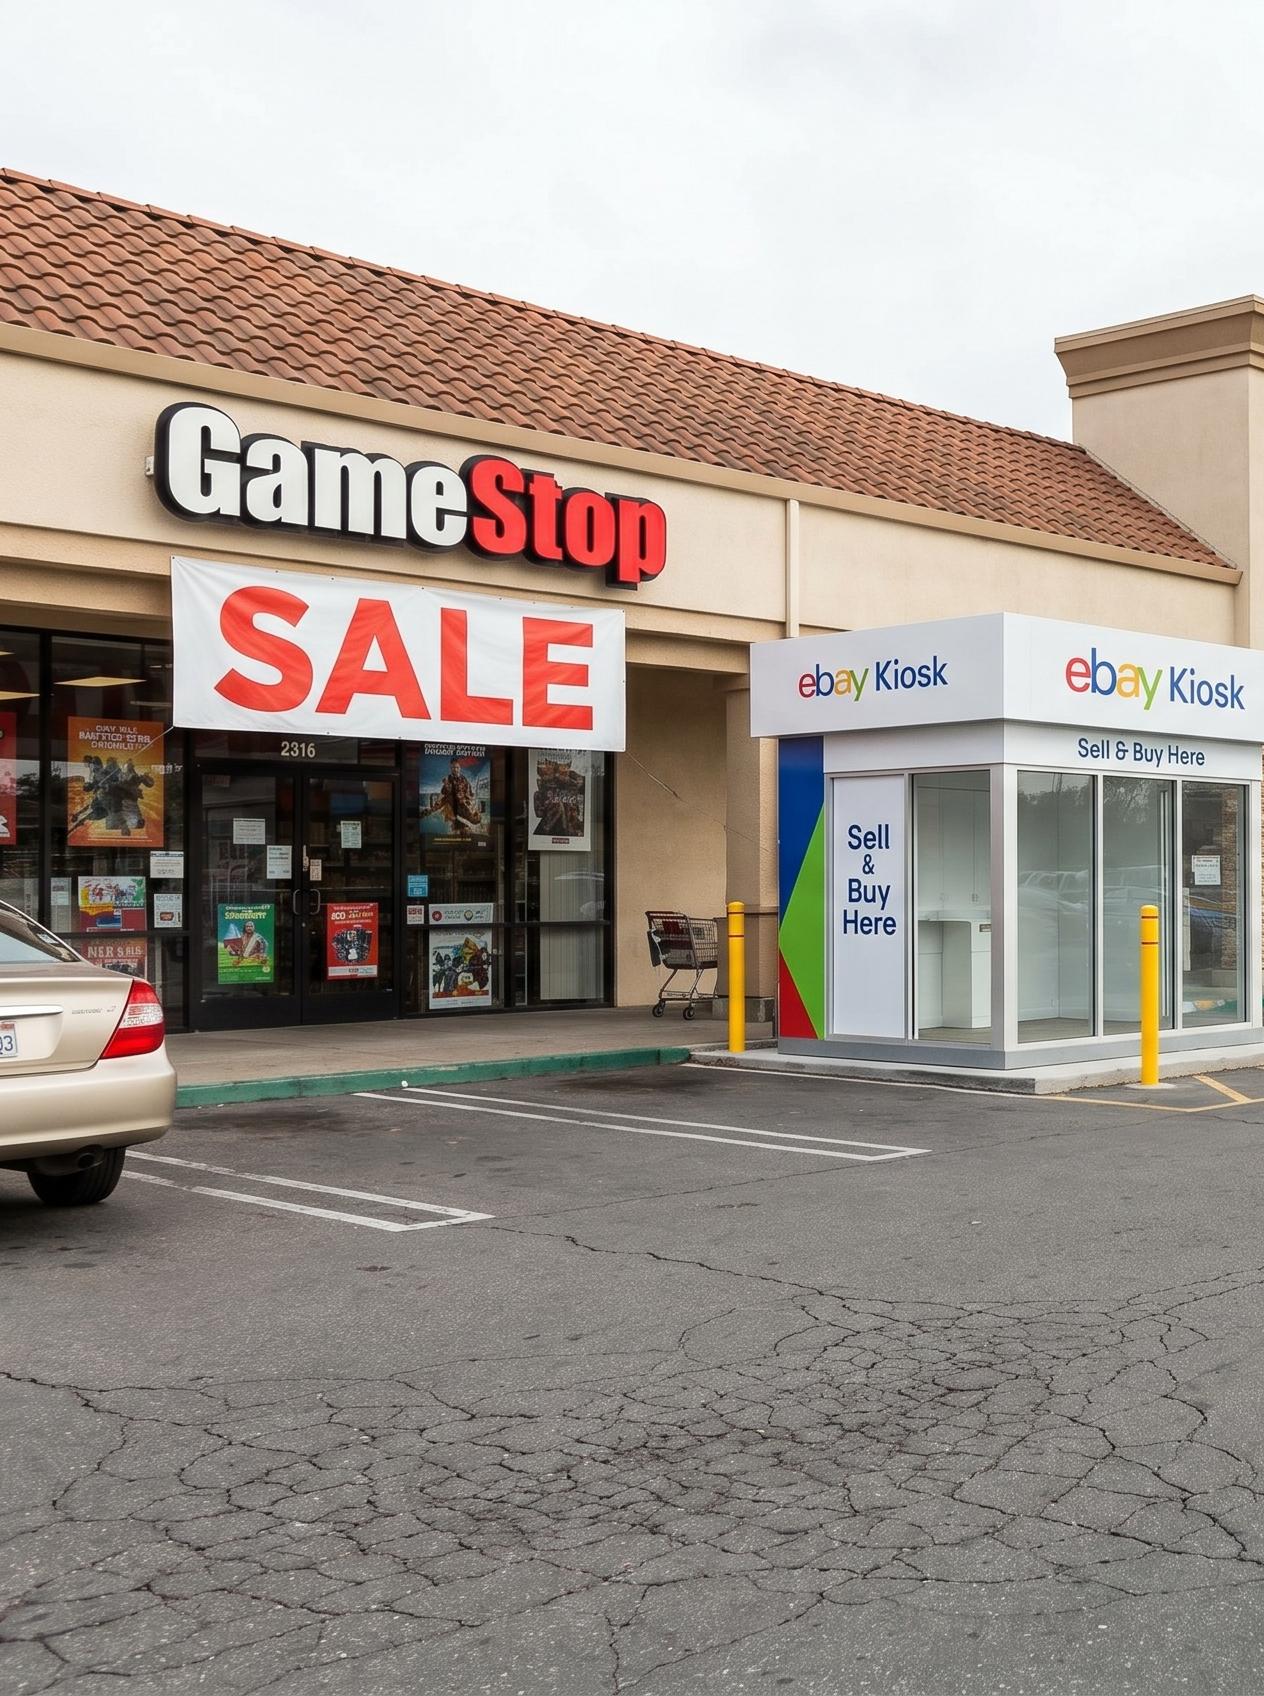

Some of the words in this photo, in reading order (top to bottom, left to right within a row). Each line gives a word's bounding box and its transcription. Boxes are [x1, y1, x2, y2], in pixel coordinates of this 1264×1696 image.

[158, 403, 667, 589] GameStop
[214, 585, 594, 731] SALE
[798, 663, 869, 703] ebay
[875, 655, 949, 693] Kiosk
[1065, 648, 1163, 711] ebay
[1170, 666, 1246, 711] Kiosk
[280, 740, 316, 758] 2316
[1077, 738, 1111, 760] Sell
[1115, 743, 1130, 762] &
[1132, 742, 1165, 768] Buy
[1167, 744, 1206, 767] Here
[847, 824, 890, 850] Sell
[862, 853, 875, 875] &
[847, 878, 892, 908] Buy
[842, 910, 897, 936] Here
